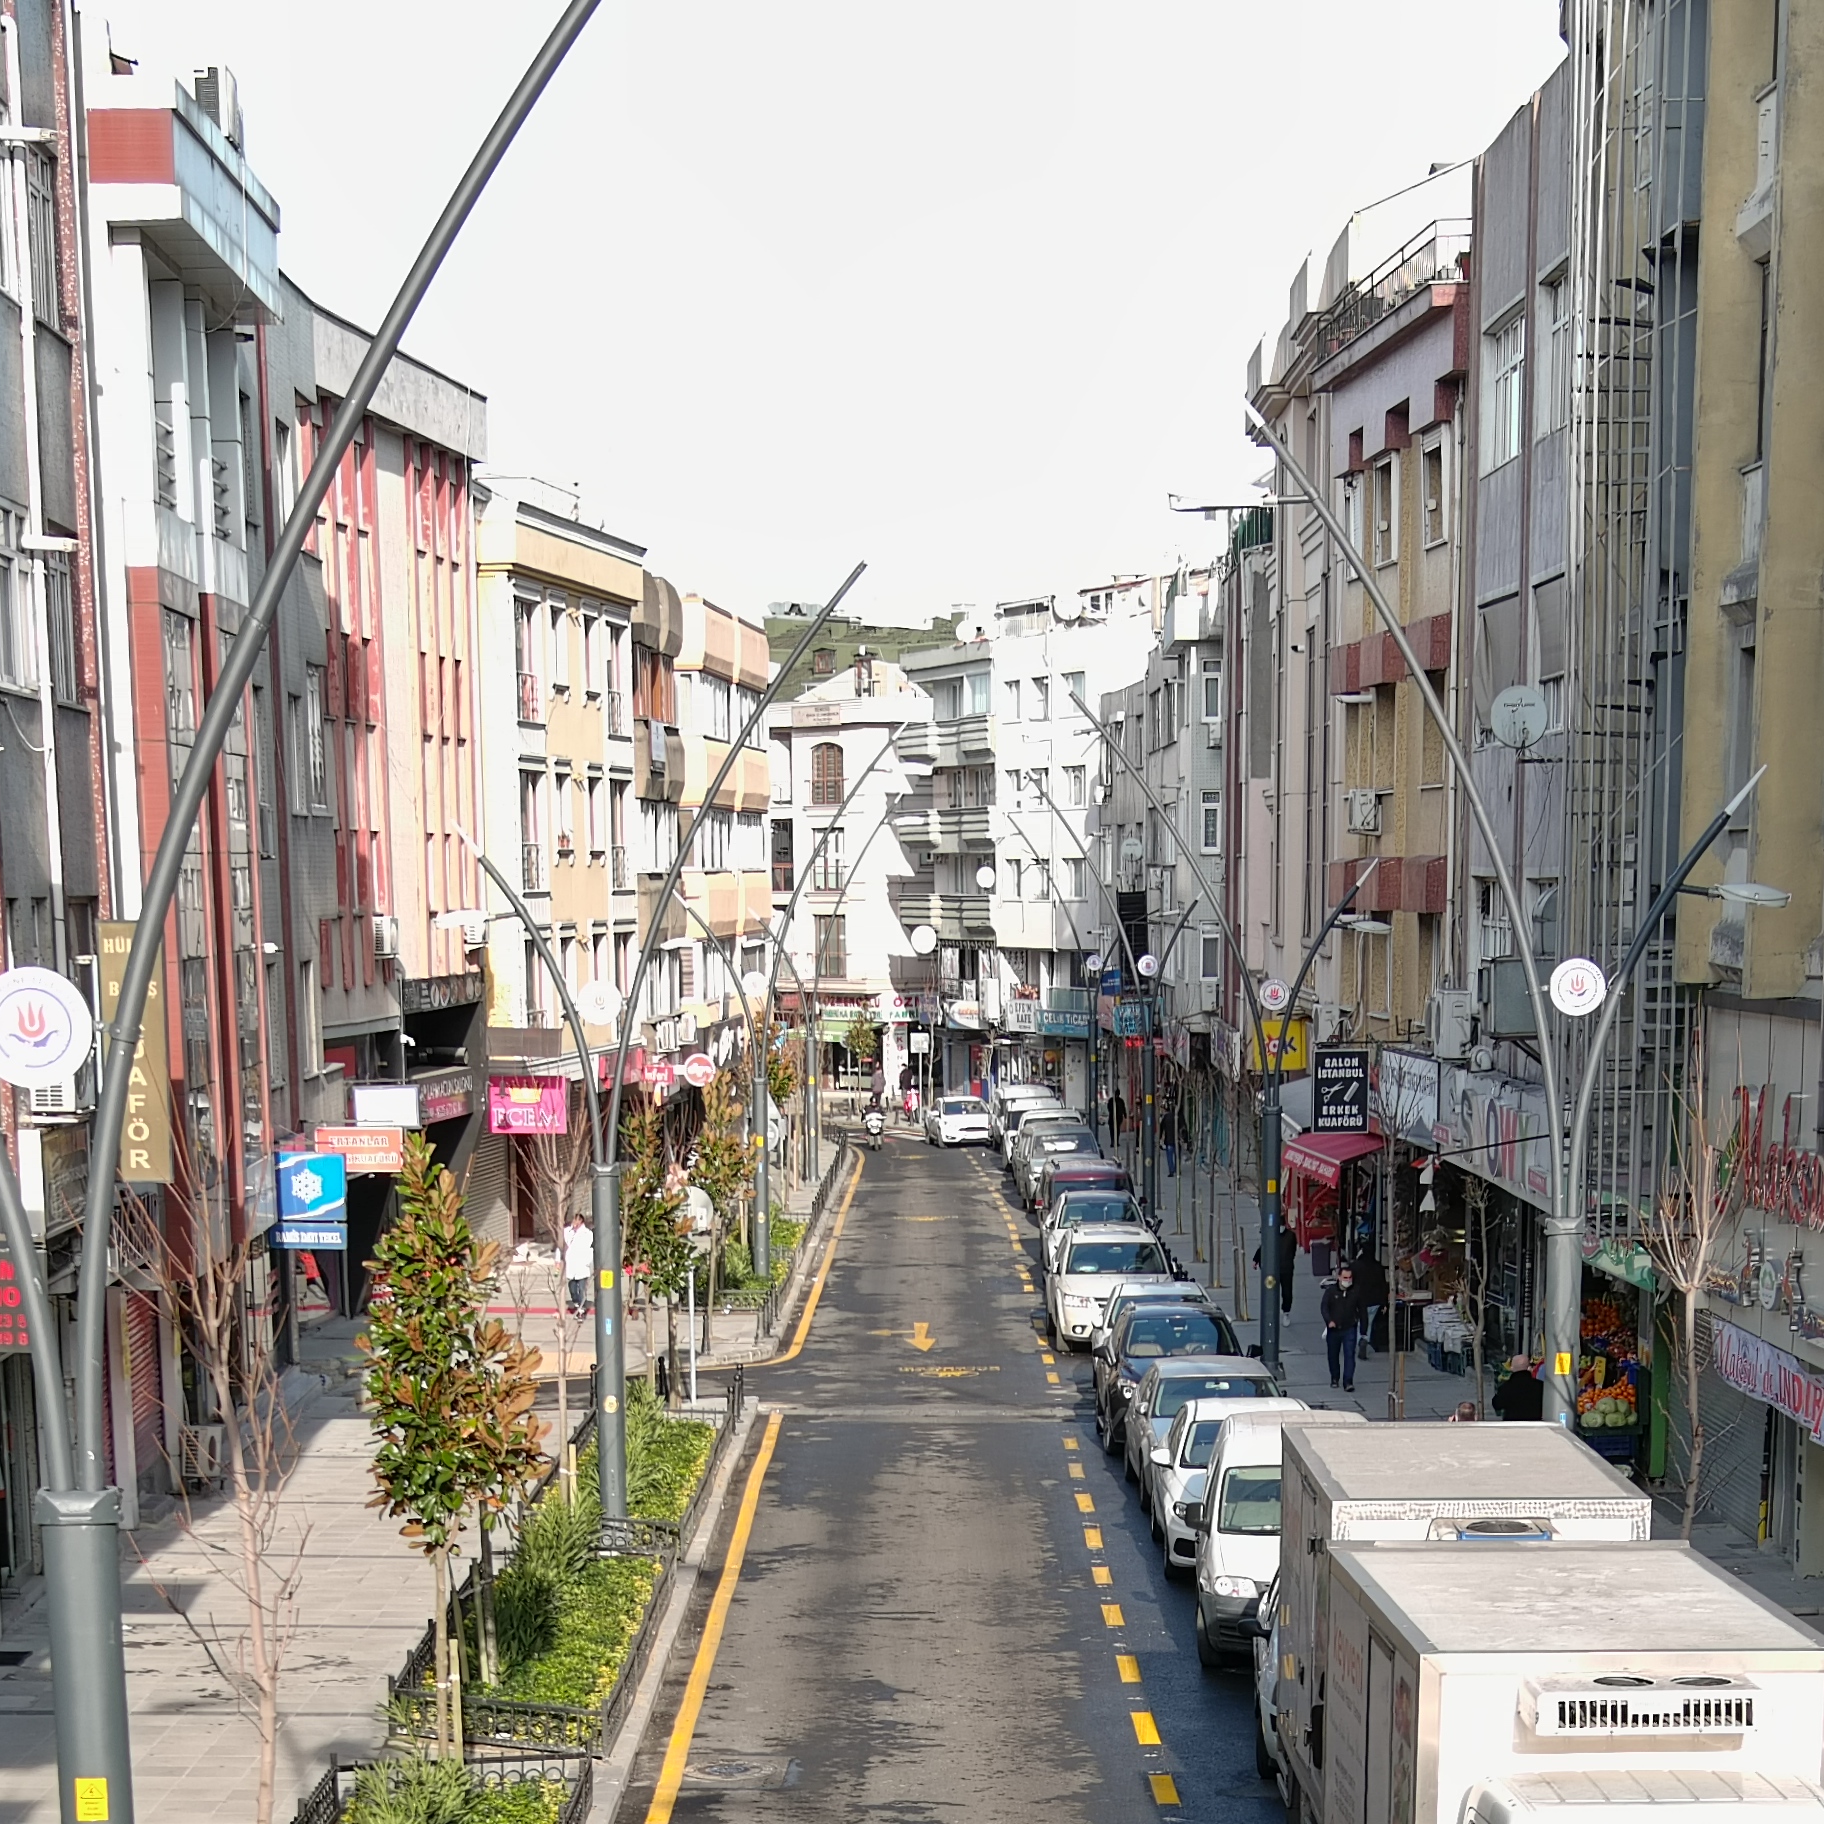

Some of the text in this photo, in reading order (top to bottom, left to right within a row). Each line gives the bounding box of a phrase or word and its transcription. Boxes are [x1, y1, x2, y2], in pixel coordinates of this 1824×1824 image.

[1323, 1057, 1359, 1068] SALON
[1317, 1066, 1365, 1080] İSTANBUL
[1321, 1105, 1359, 1116] ERKEK
[1317, 1114, 1364, 1128] KUAFÖRÜ
